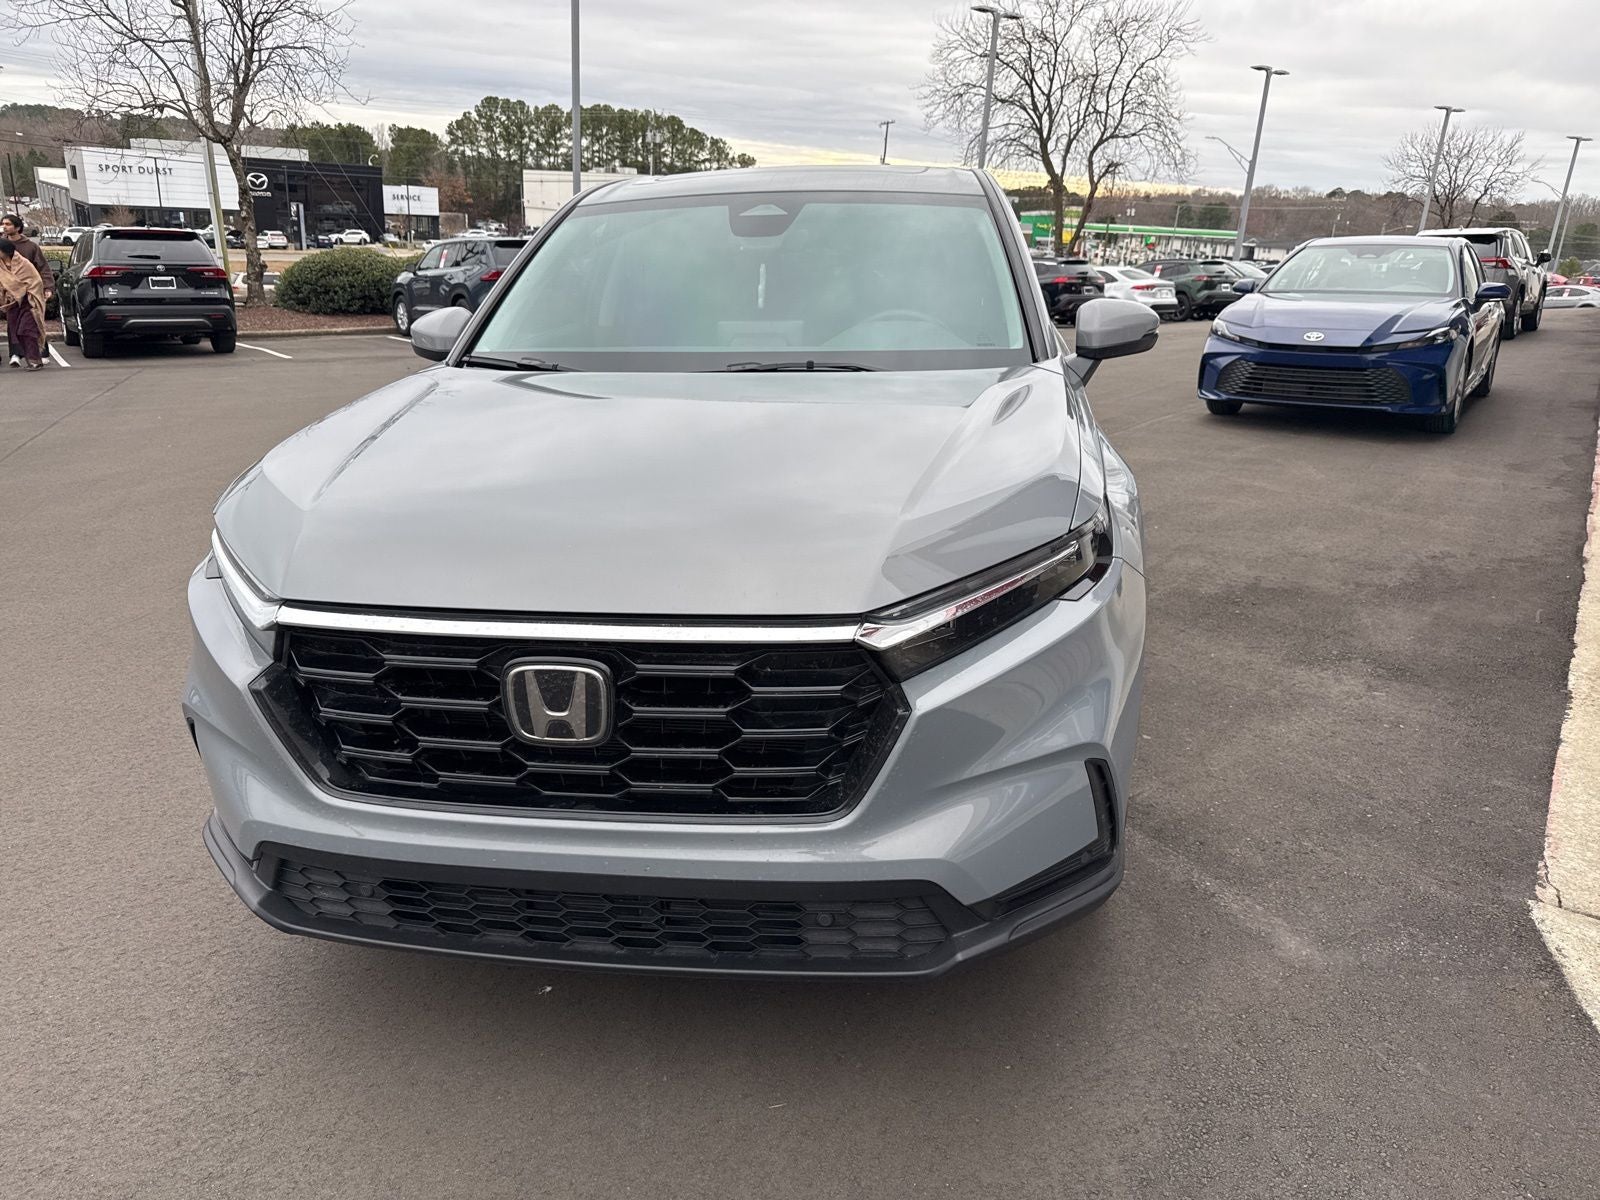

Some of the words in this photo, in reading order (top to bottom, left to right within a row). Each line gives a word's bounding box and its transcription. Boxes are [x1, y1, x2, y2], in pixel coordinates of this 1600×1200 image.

[98, 164, 133, 174] SPORT
[138, 166, 173, 175] DURST
[392, 193, 421, 202] SERVICE
